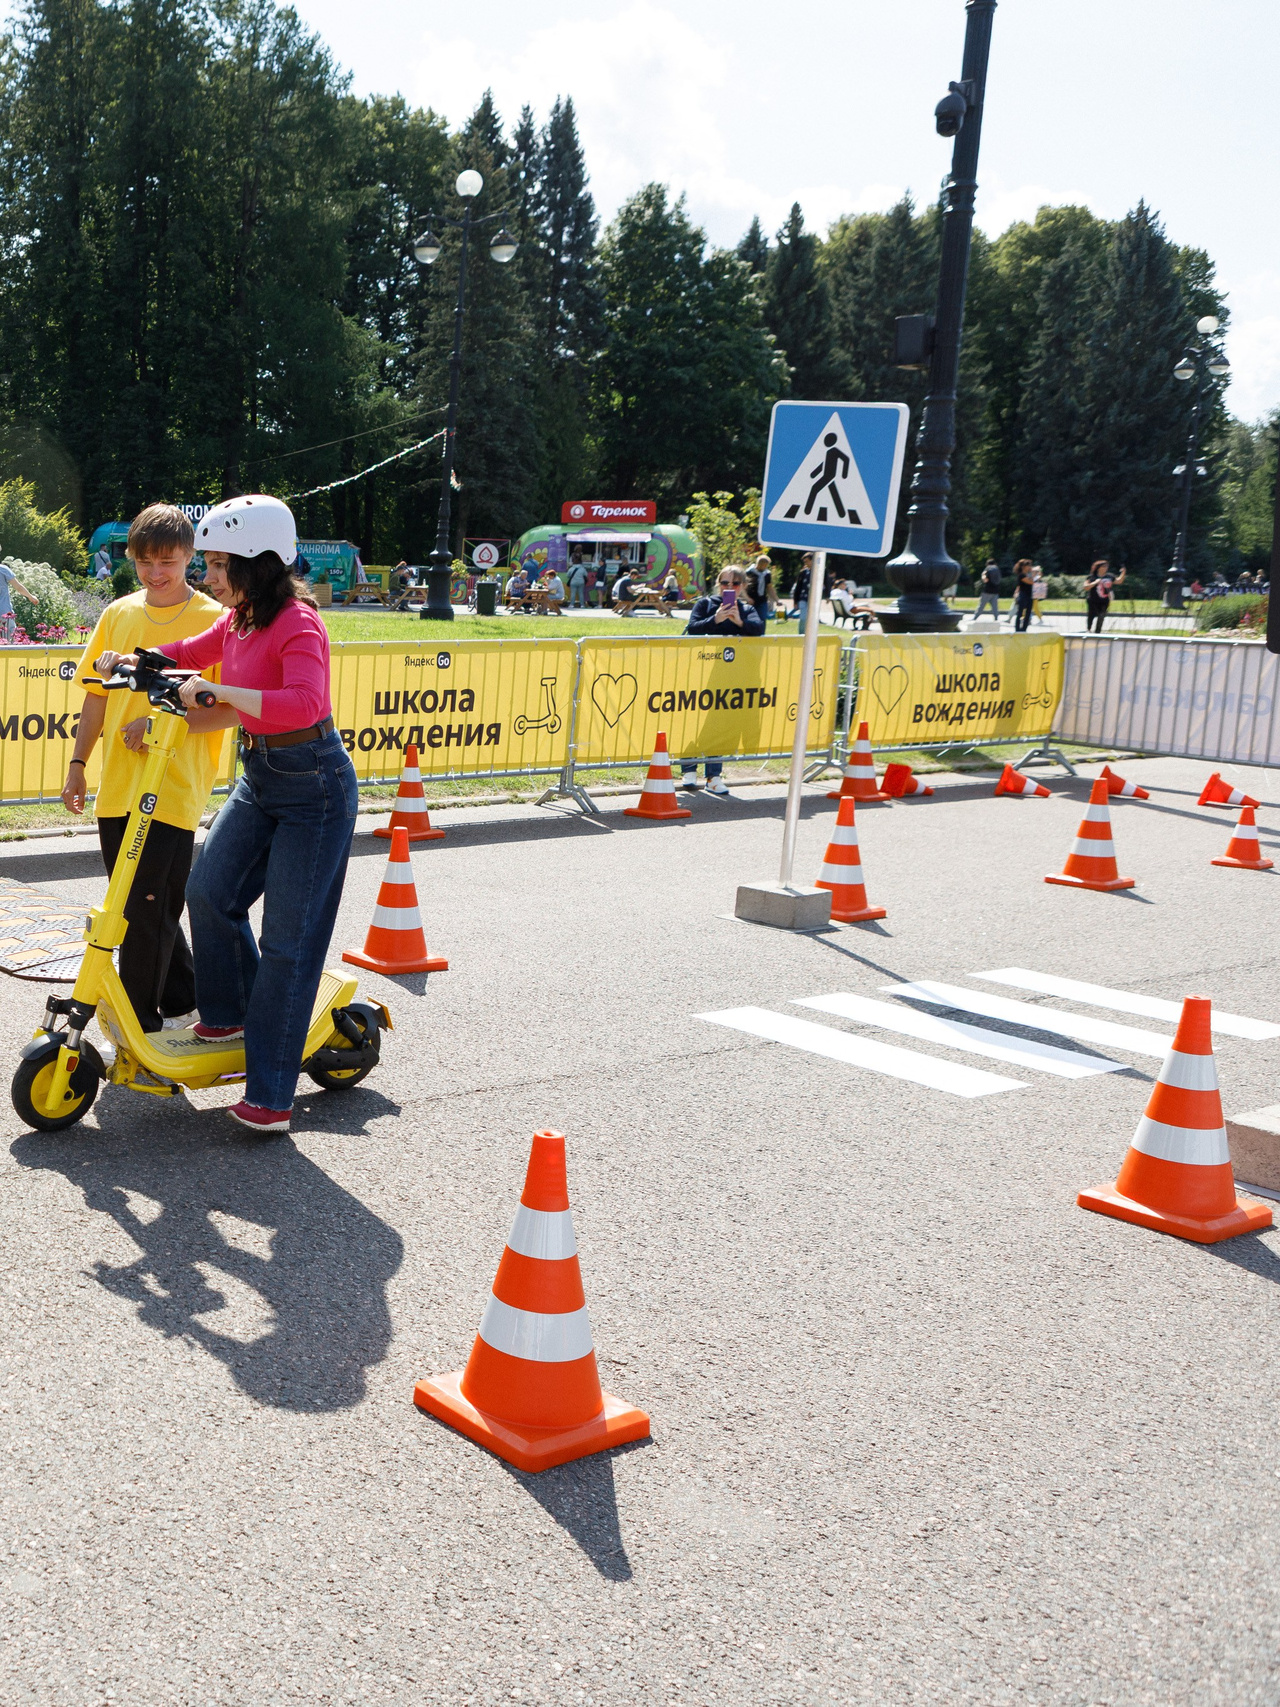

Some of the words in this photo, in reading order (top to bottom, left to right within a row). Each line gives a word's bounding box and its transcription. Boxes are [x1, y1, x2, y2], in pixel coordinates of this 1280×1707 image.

[591, 505, 647, 518] Теремок
[404, 656, 435, 667] Яндекс
[438, 654, 450, 666] Go
[697, 651, 722, 661] Яндекс
[724, 649, 734, 660] Go
[18, 666, 56, 679] Яндекс
[60, 664, 76, 677] Go
[936, 672, 1000, 693] школа
[374, 688, 475, 715] школа
[648, 687, 777, 713] самокаты
[912, 700, 1015, 726] вождения
[340, 722, 501, 755] вождения
[126, 816, 150, 861] Яндекс
[142, 795, 157, 813] Go
